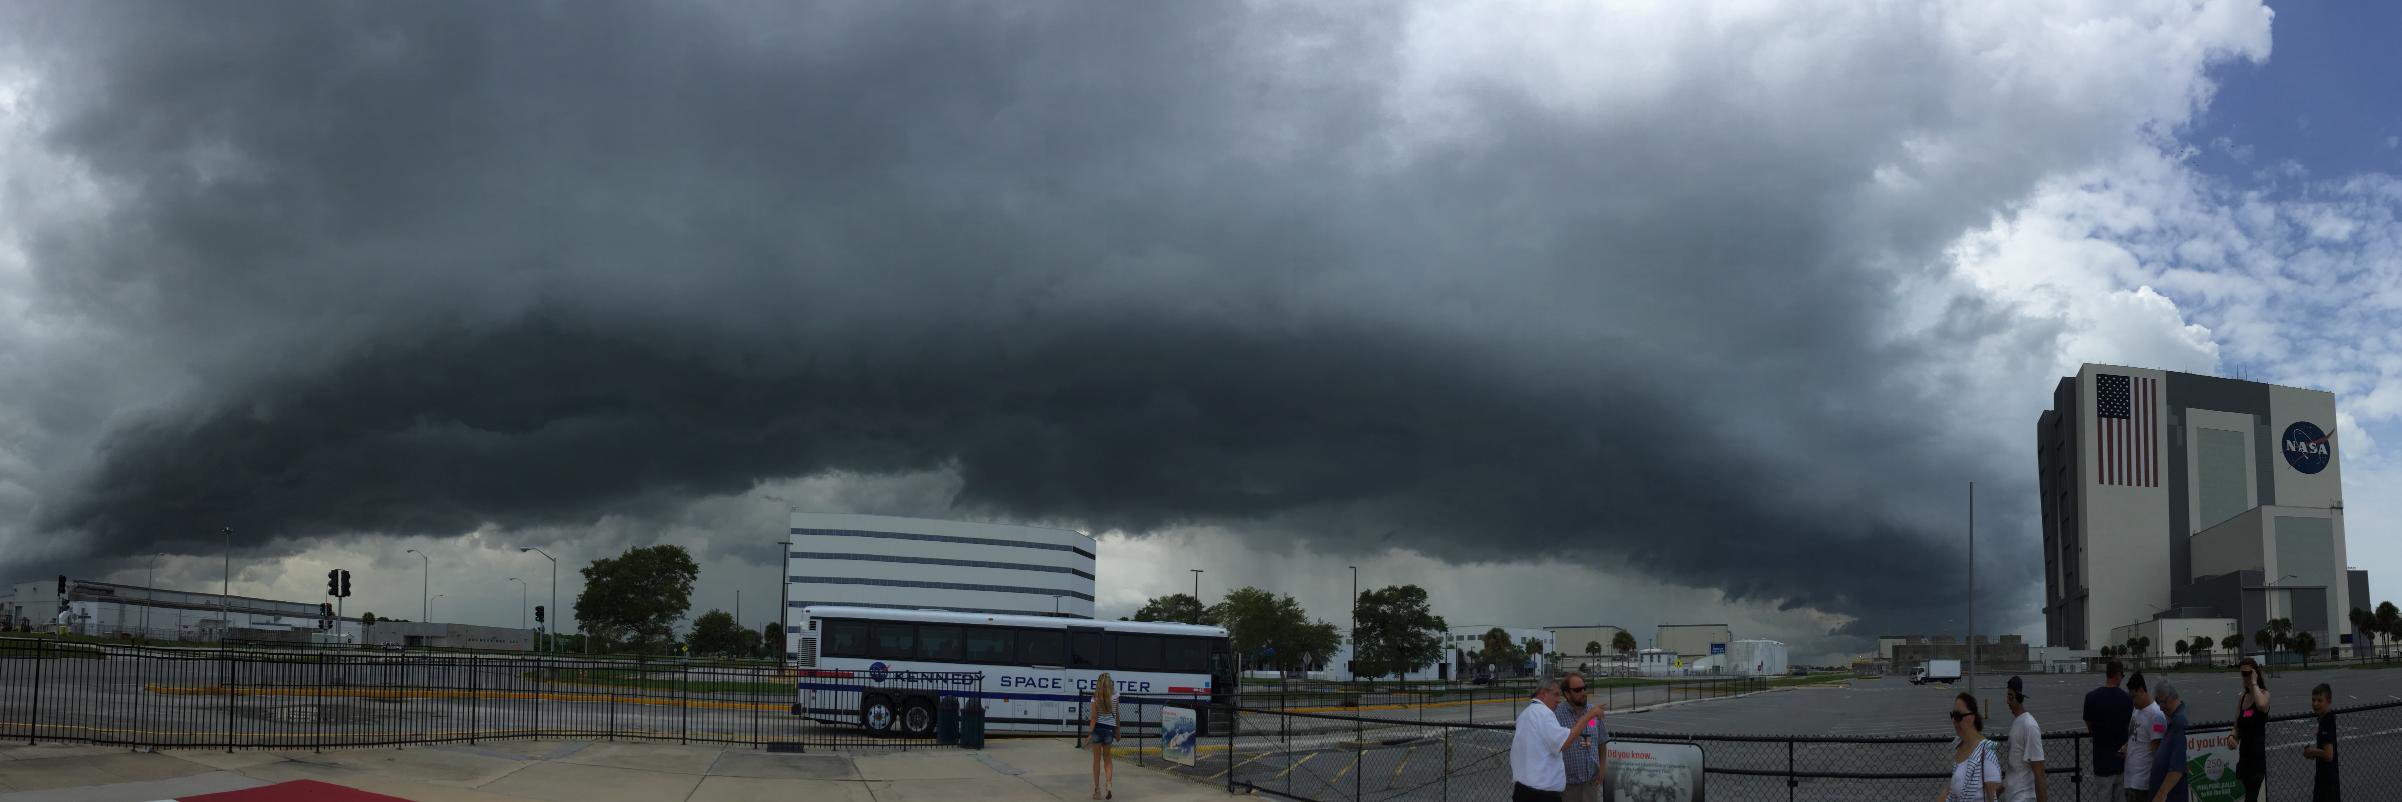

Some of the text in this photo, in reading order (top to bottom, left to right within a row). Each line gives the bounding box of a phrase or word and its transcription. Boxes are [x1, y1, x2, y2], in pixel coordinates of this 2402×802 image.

[2286, 439, 2328, 455] NASA
[895, 671, 985, 685] KENNEDY
[1000, 676, 1062, 689] SPACE
[1076, 678, 1151, 692] CETER
[2196, 738, 2215, 751] you
[1608, 749, 1617, 758] Did
[1617, 751, 1630, 760] you
[2207, 758, 2222, 768] 250
